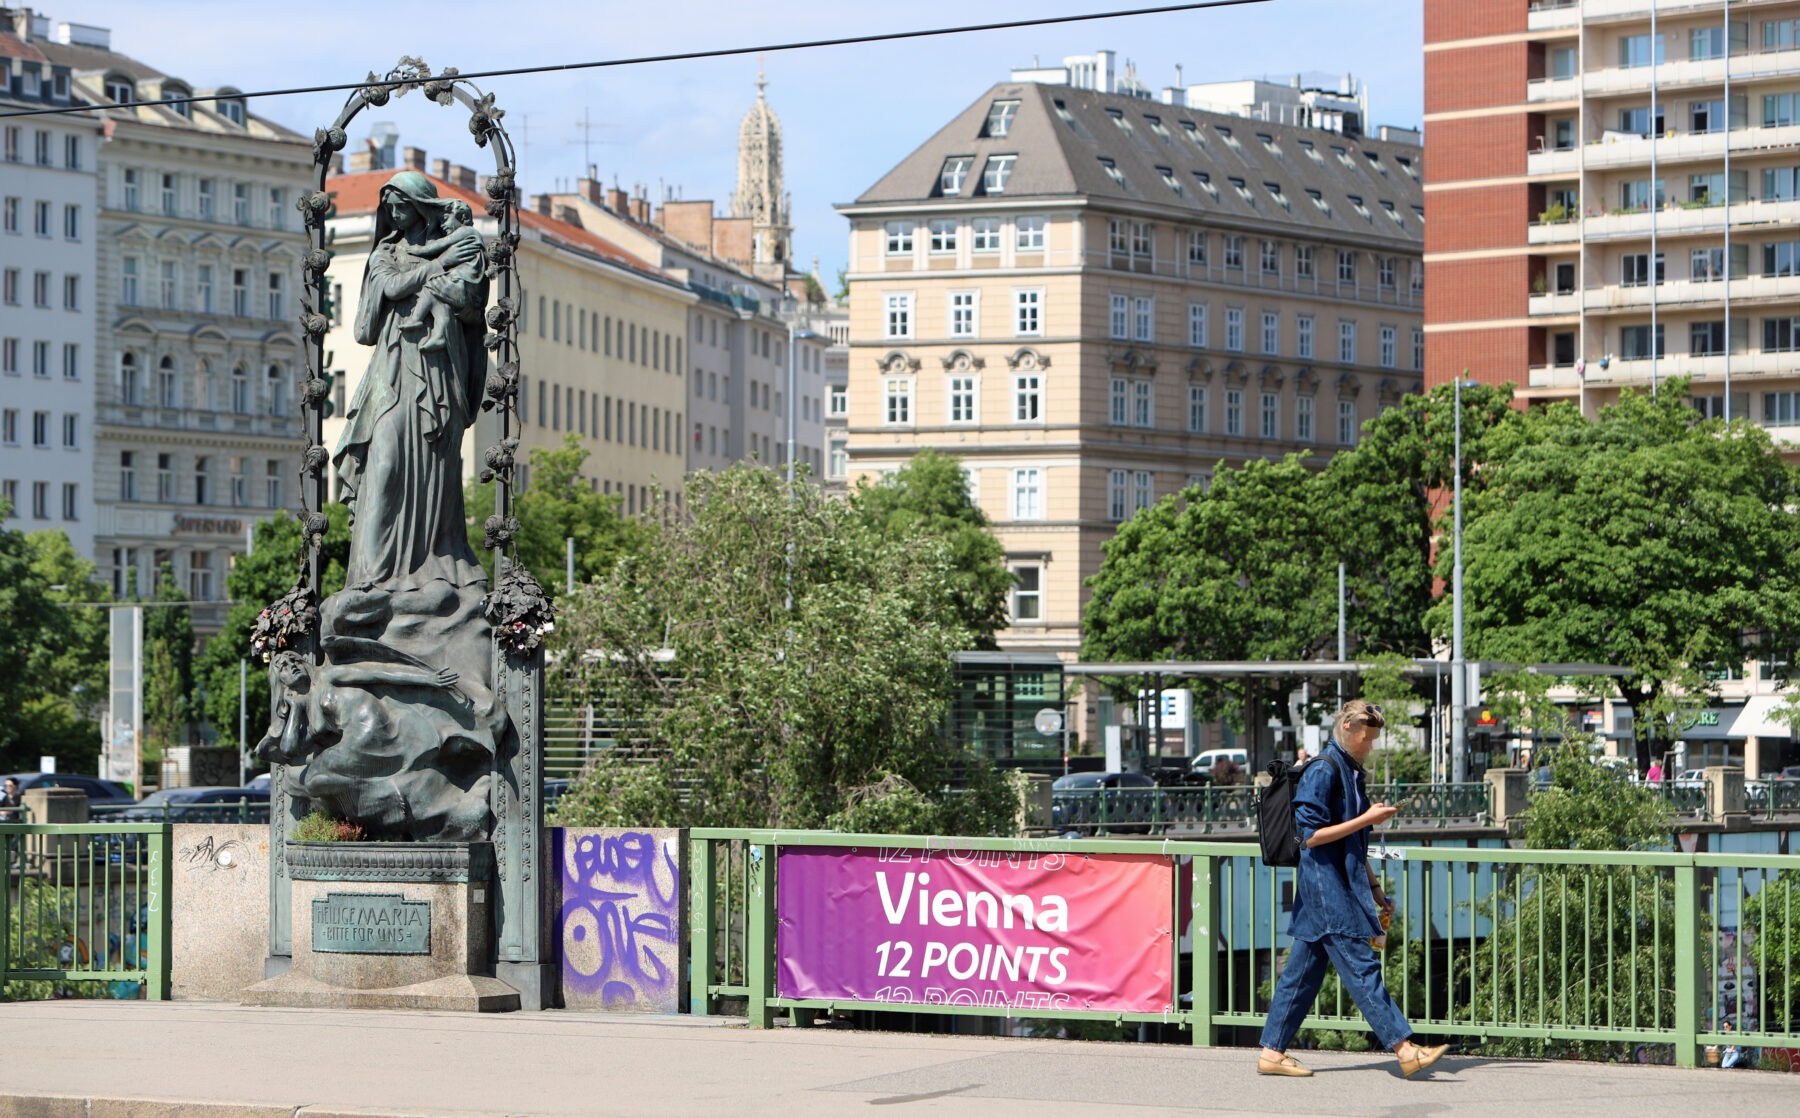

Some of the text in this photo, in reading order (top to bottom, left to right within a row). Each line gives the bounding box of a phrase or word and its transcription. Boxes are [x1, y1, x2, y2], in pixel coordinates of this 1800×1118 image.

[317, 906, 422, 926] HEILIGE MARIA
[875, 871, 1069, 933] Vienna
[327, 926, 349, 941] BITTE
[875, 940, 1070, 985] 12 POINTS
